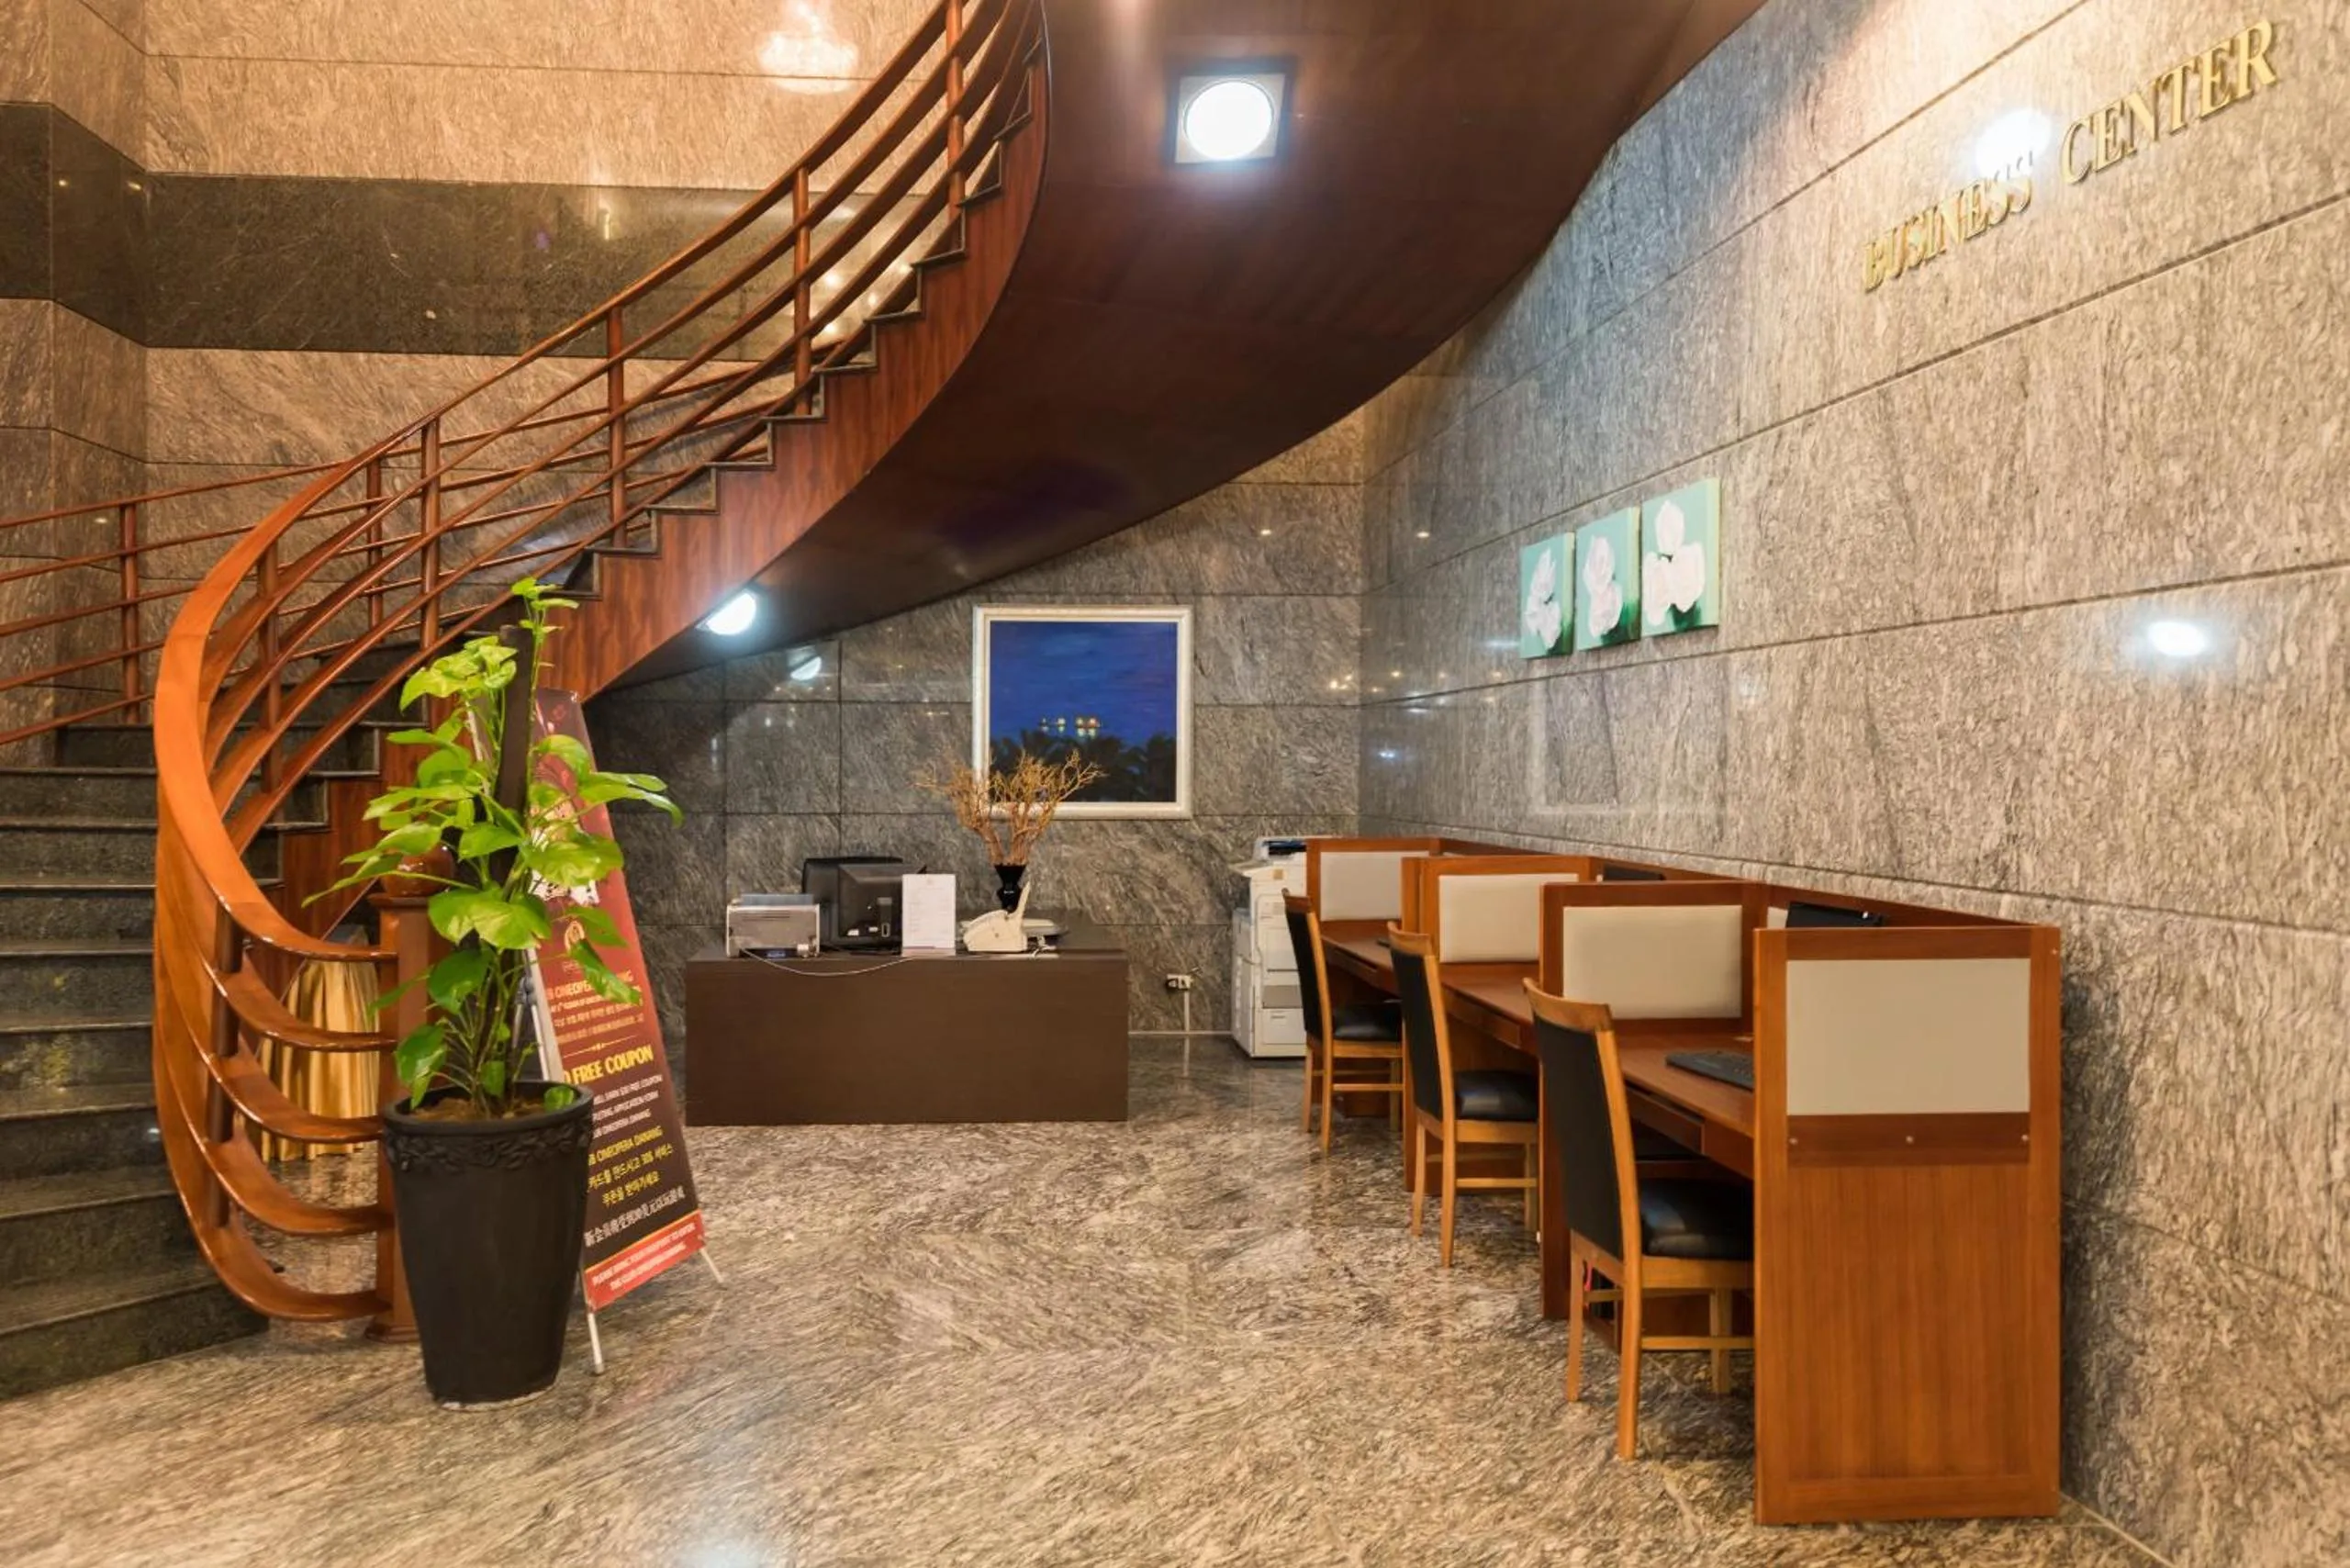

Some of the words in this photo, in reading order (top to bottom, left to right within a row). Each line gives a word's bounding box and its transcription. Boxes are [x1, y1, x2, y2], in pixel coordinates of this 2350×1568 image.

[1862, 150, 2033, 292] BUSINESS
[2060, 20, 2278, 185] CENTER
[572, 1060, 604, 1085] FREE
[605, 1044, 655, 1074] COUPON
